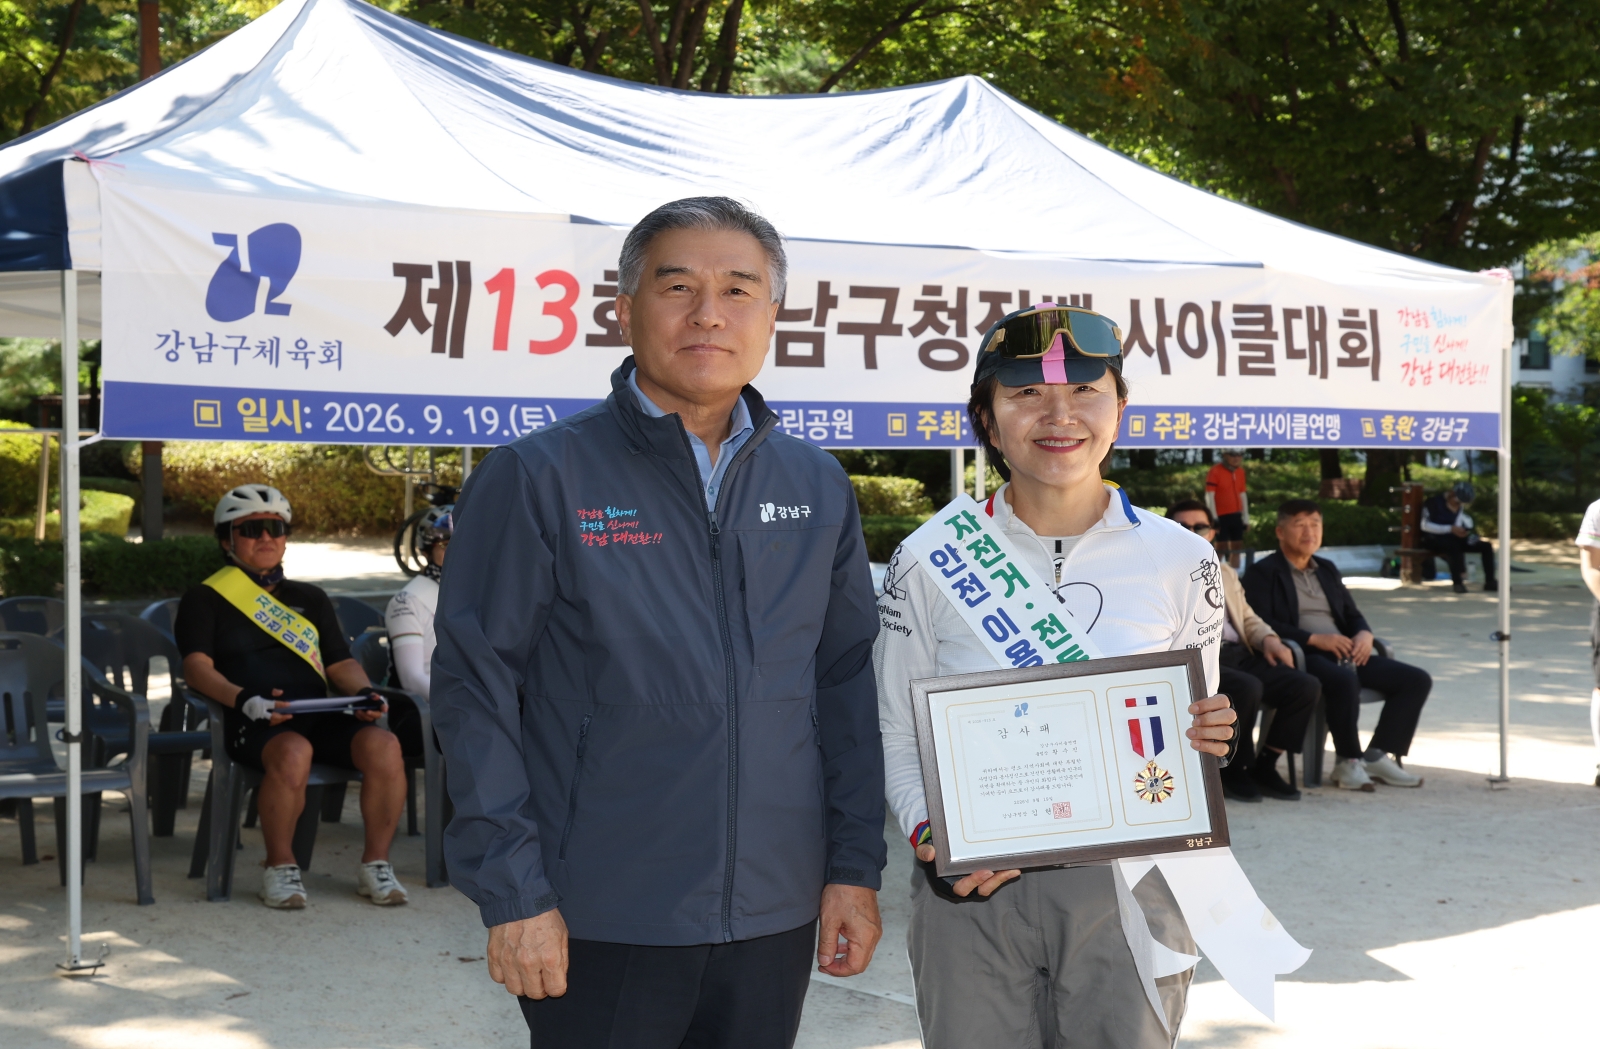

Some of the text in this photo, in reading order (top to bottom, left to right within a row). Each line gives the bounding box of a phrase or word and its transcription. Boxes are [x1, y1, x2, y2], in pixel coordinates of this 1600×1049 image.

[154, 329, 343, 371] 강남구체육회
[1124, 297, 1381, 382] 사이클대회
[1401, 357, 1434, 387] 강남
[323, 401, 415, 435] 2026.
[423, 404, 454, 436] 9.
[771, 408, 853, 441] 린공원
[1203, 412, 1341, 442] 강남구사이클연맹
[1380, 415, 1469, 442] 후원: 강남구
[577, 505, 638, 520] 강남을 힘차게!
[580, 519, 640, 531] 구민을 신나게!
[776, 505, 812, 519] 강남구
[581, 530, 663, 547] 강남 대전환!!
[929, 543, 991, 608] 안전
[882, 618, 912, 637] Society
[1186, 837, 1213, 848] 강남구
